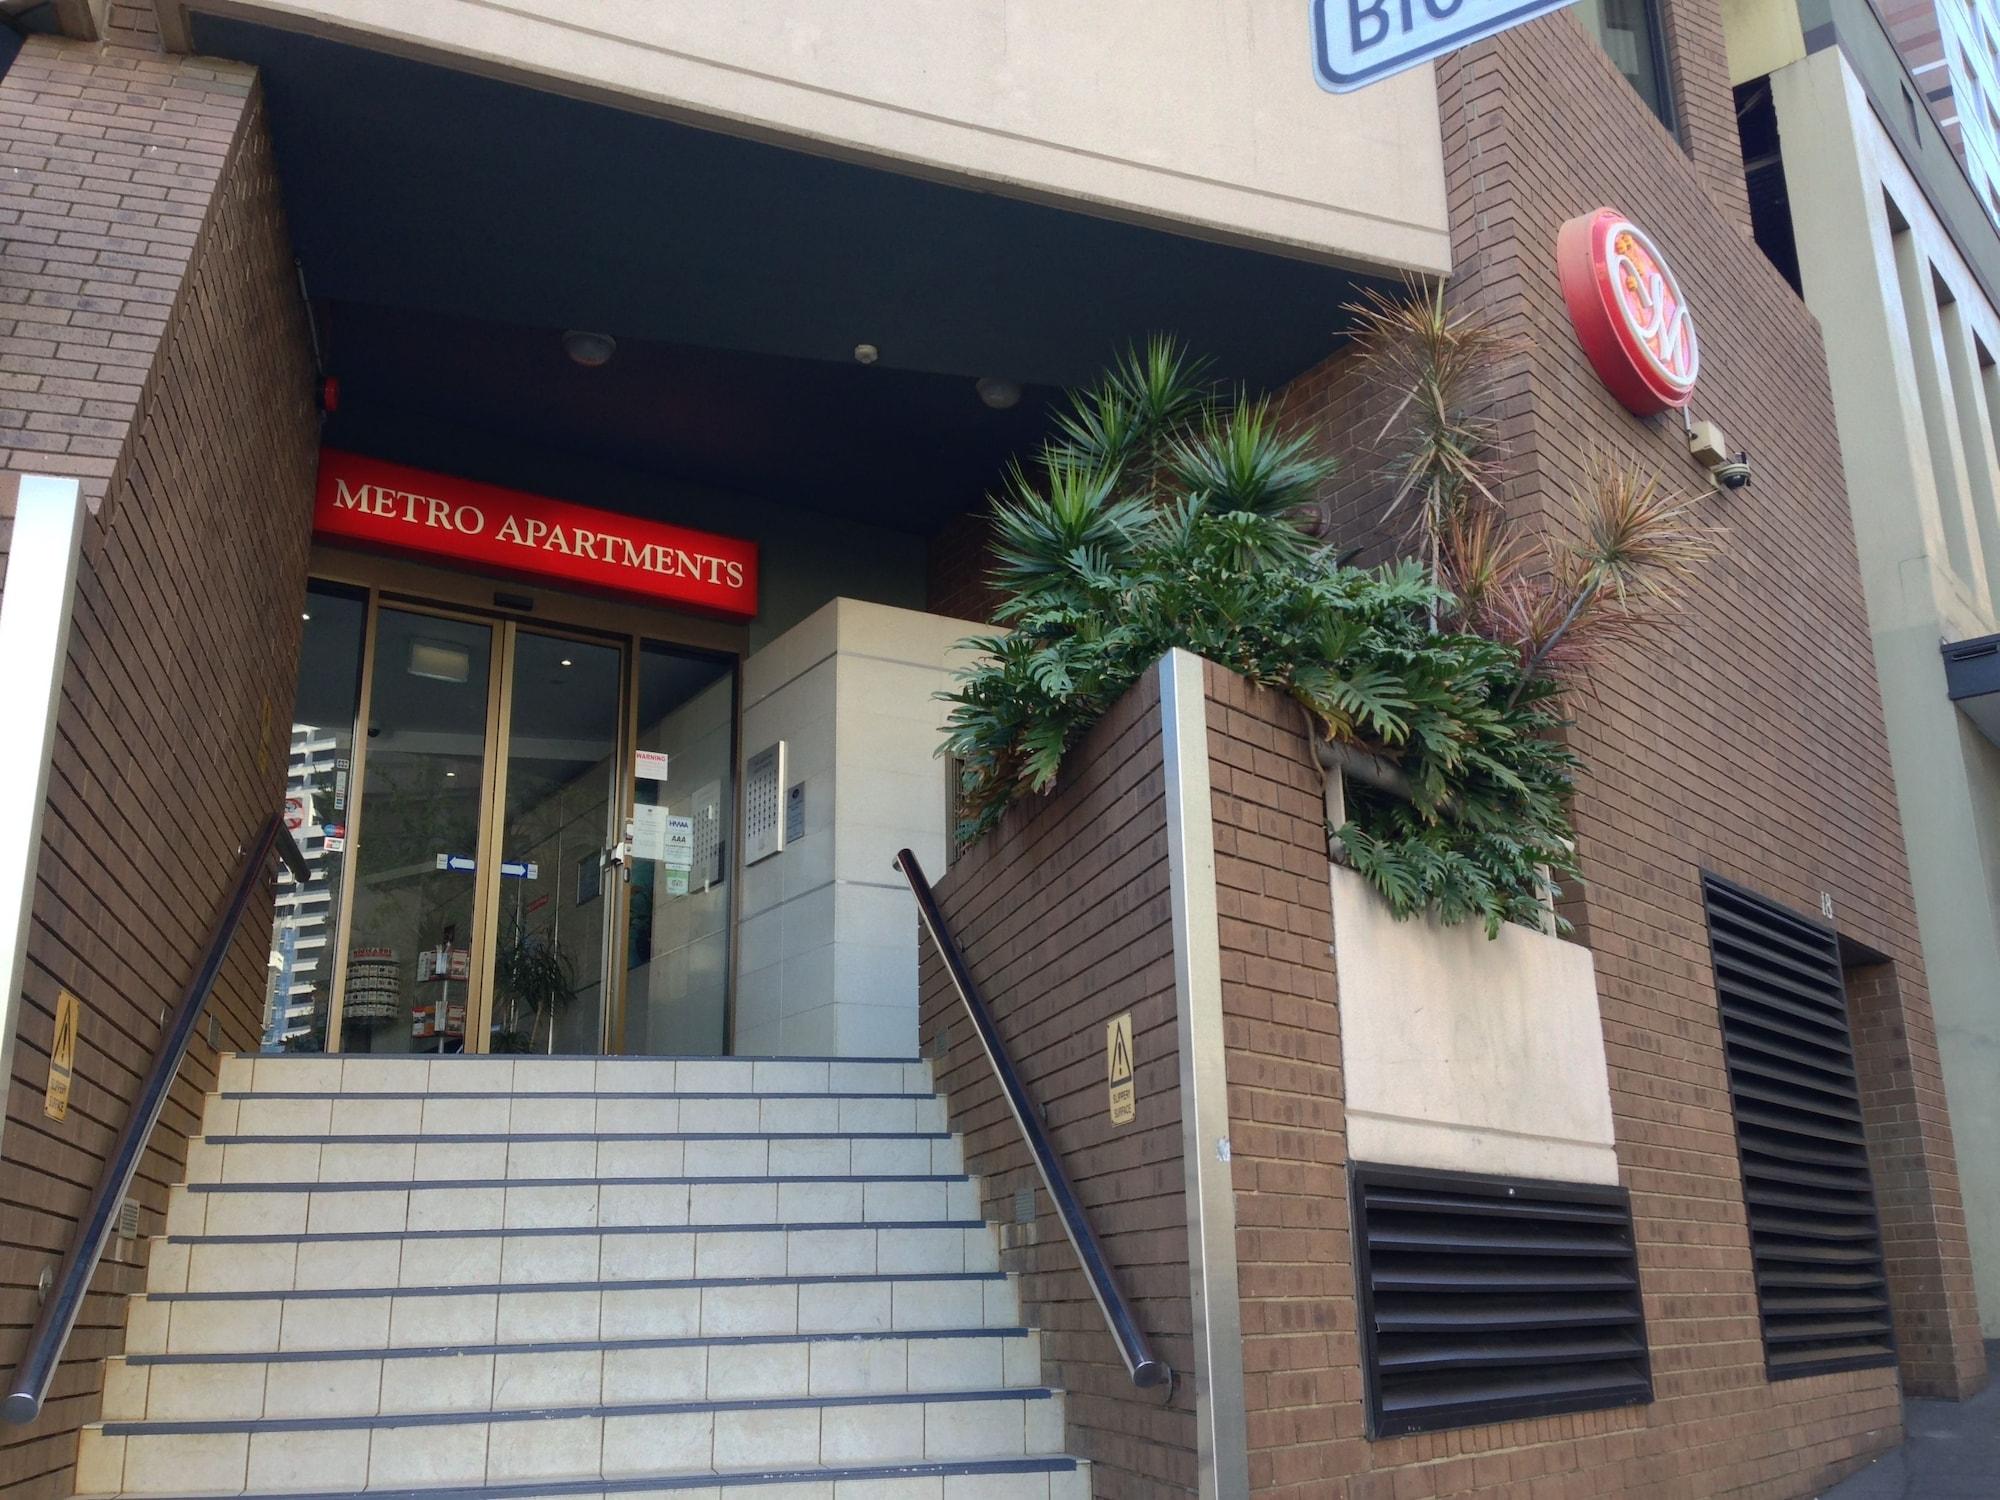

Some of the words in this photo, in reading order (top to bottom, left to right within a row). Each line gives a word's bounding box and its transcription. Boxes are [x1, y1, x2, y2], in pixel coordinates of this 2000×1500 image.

[333, 478, 485, 535] METRO
[494, 514, 744, 588] APARTMENTS
[636, 753, 666, 762] WARNING
[671, 835, 686, 843] AAA
[1820, 891, 1833, 919] 18
